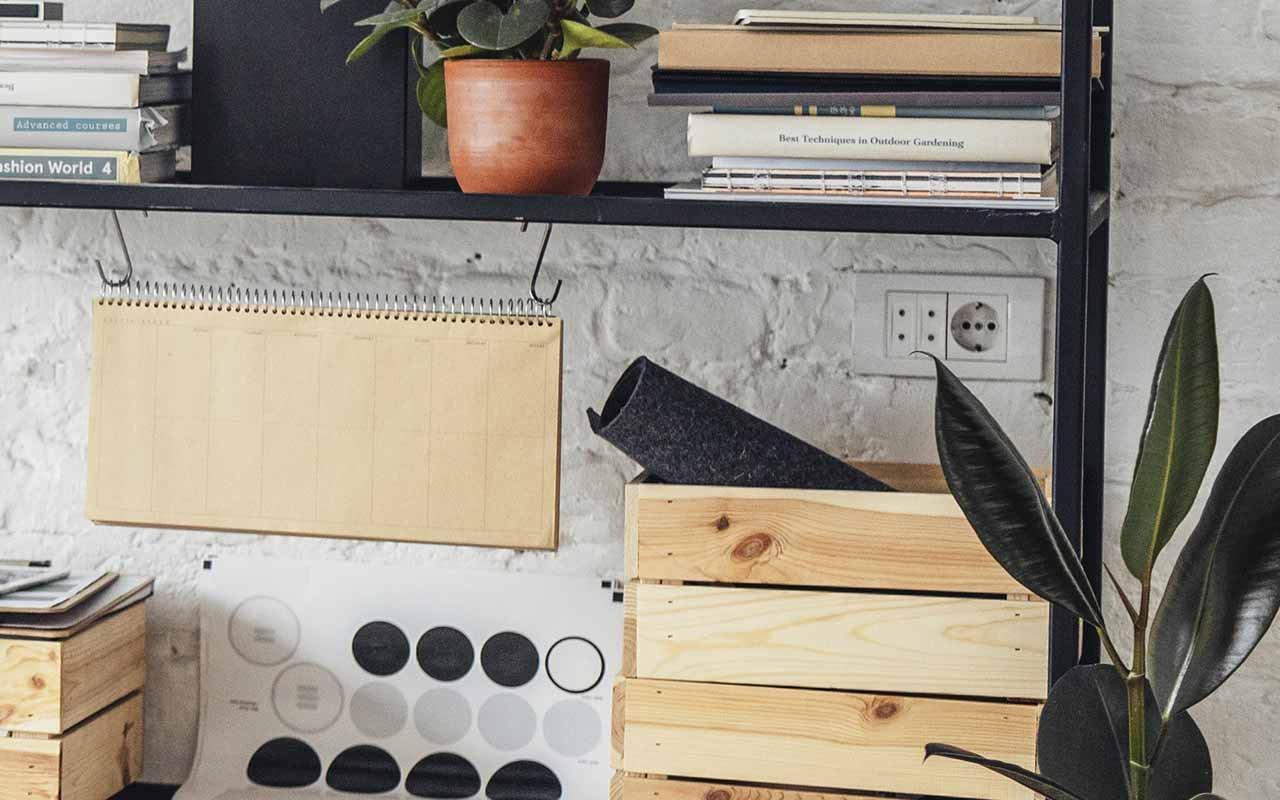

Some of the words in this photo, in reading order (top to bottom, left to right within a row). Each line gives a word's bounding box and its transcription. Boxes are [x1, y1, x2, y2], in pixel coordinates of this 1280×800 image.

[16, 119, 69, 130] Advanced
[75, 122, 121, 131] courses
[778, 134, 799, 143] Best
[802, 135, 856, 147] Techniques
[858, 136, 868, 145] in
[870, 136, 910, 146] Outdoor
[913, 137, 965, 149] Gardening
[48, 160, 93, 175] World
[101, 161, 112, 175] 4
